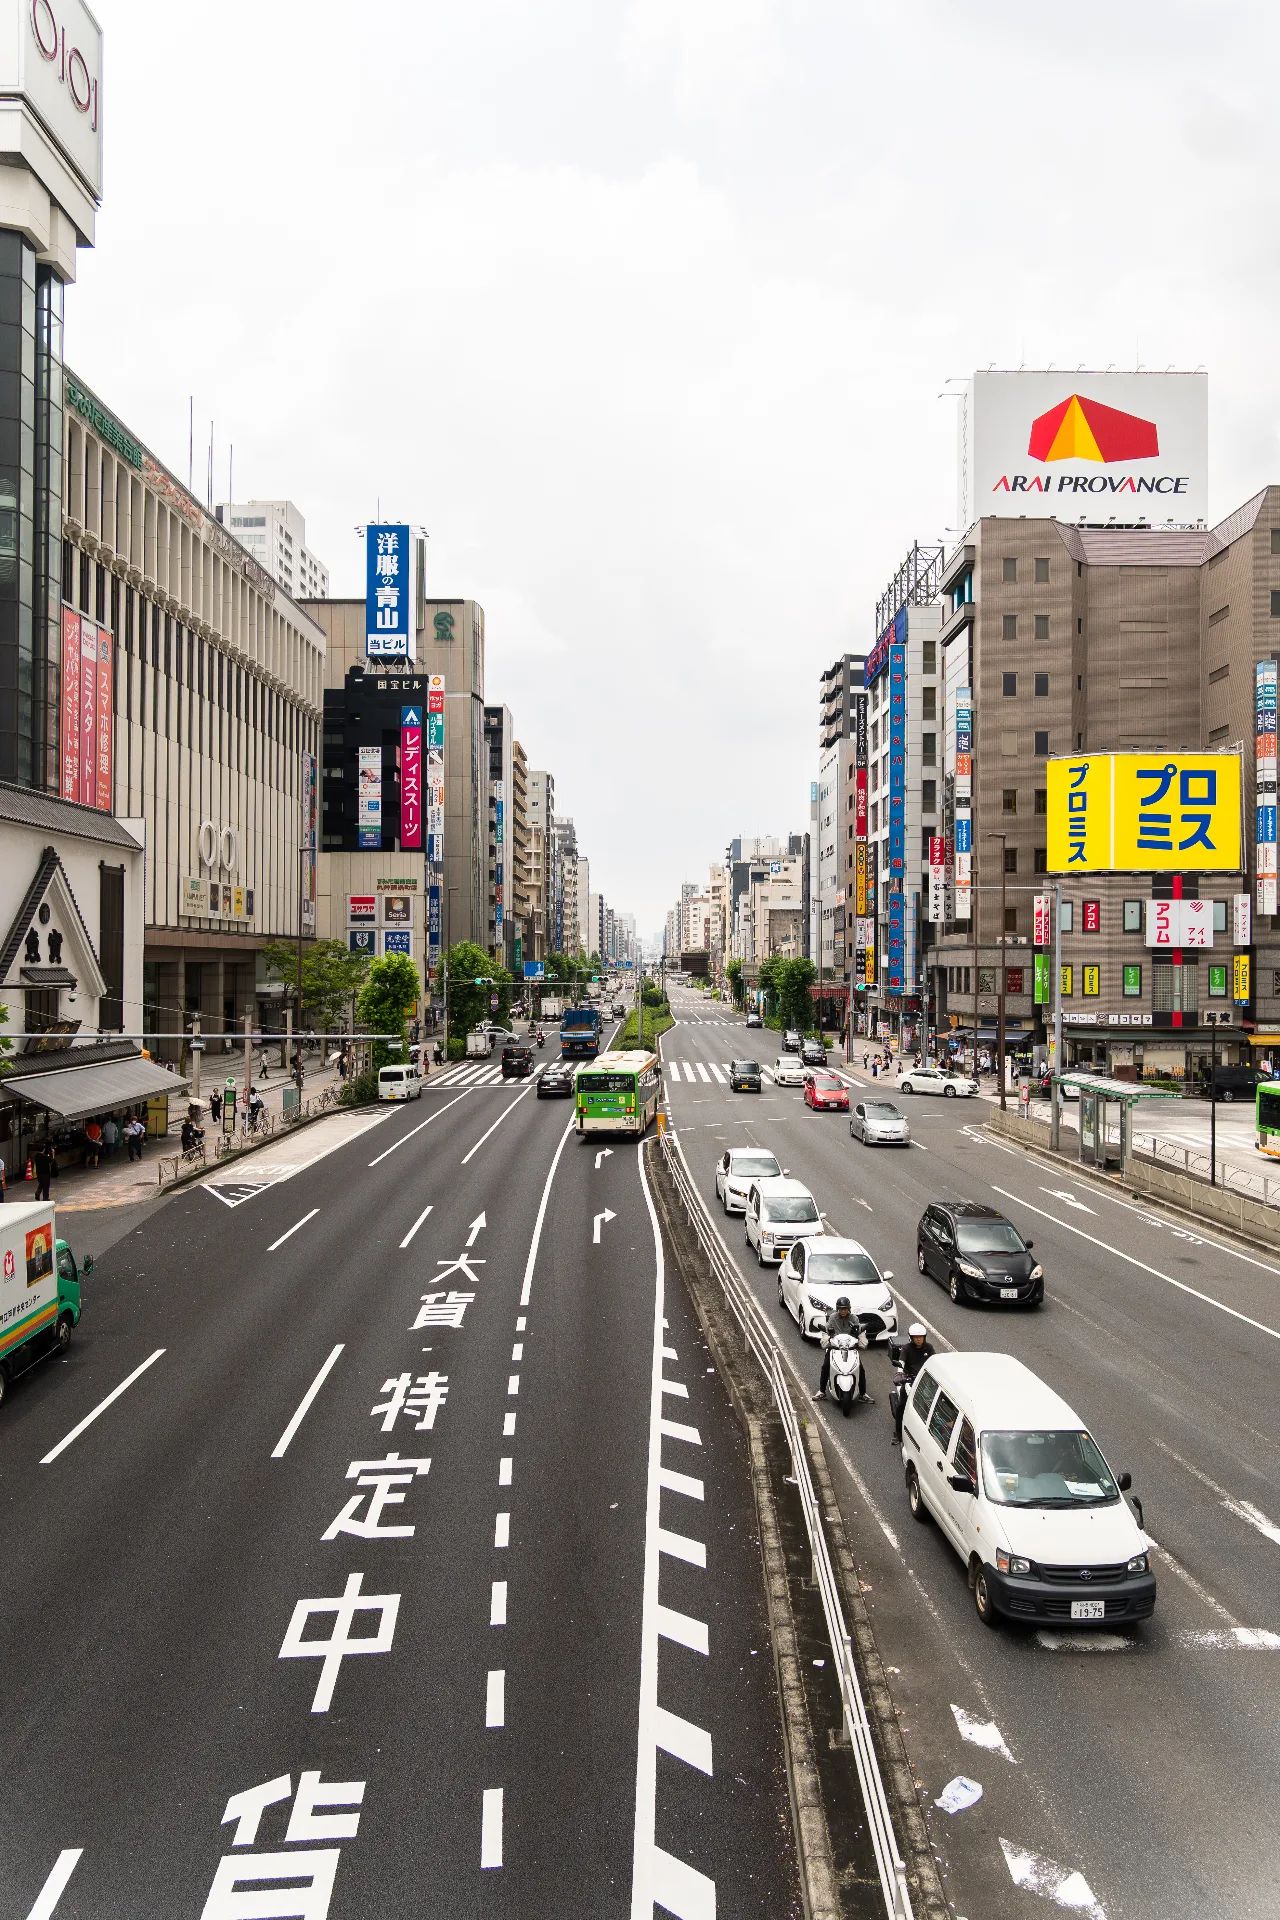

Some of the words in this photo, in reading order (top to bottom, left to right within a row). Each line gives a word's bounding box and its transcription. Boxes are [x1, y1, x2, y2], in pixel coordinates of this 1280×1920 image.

[992, 475, 1051, 492] ARAI
[1057, 476, 1190, 494] PROVANCE
[375, 532, 400, 629] 洋服の青山
[369, 639, 405, 650] 当ビル
[377, 679, 422, 690] 国宝ビル
[100, 671, 110, 776] スマホ修理
[892, 654, 903, 868] カラオケ&パーティー館
[404, 731, 420, 837] レディススーツ
[1136, 763, 1217, 806] プロ
[1068, 762, 1090, 864] プロミス
[1136, 813, 1217, 851] ミス
[933, 838, 941, 865] カラオケ
[350, 905, 375, 913] ユザワヤ
[1087, 903, 1097, 929] アコム
[1156, 902, 1171, 944] アコム
[890, 901, 901, 986] カラオケ館
[1088, 967, 1096, 993] プロミス
[1241, 963, 1249, 991] プロミス
[1079, 1607, 1103, 1618] 19-75
